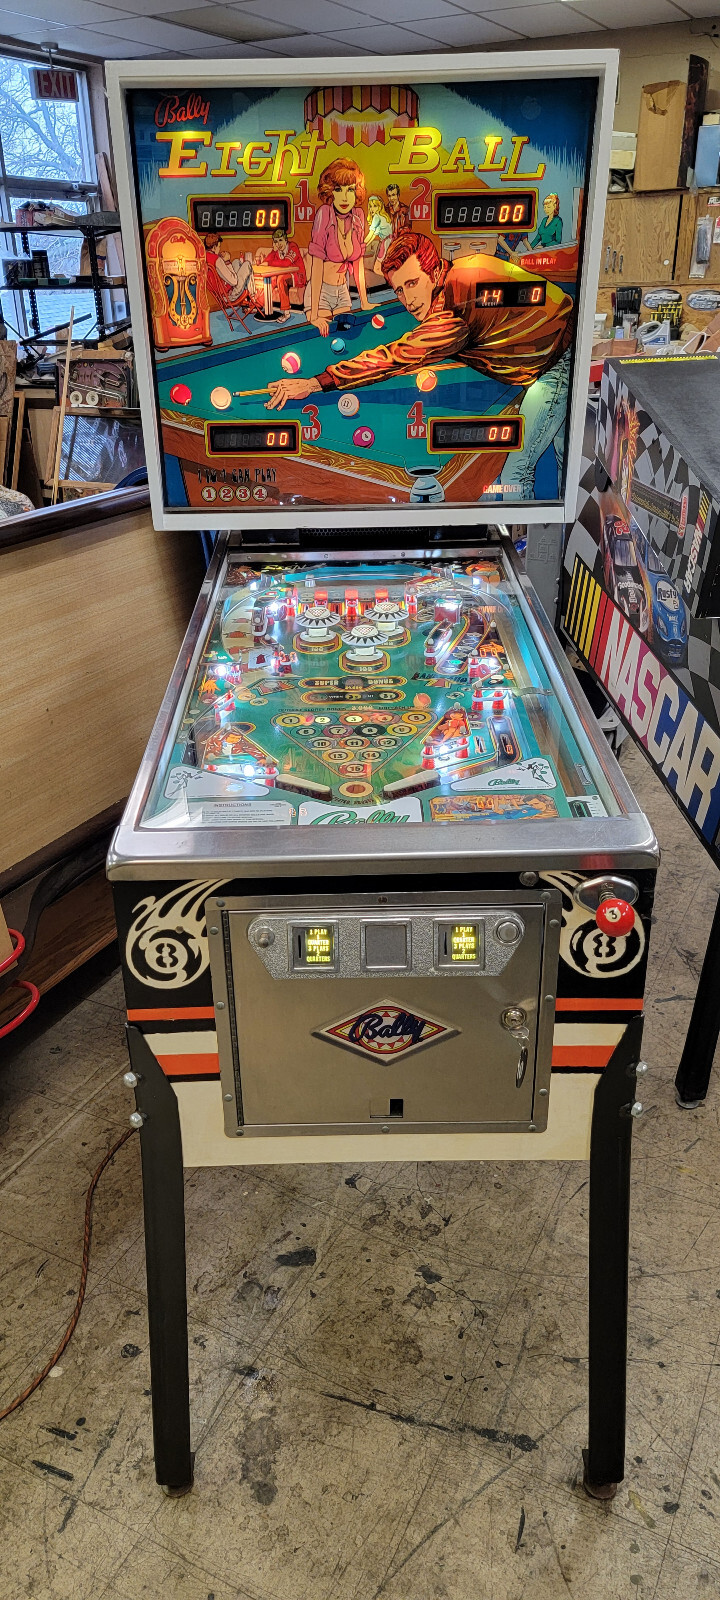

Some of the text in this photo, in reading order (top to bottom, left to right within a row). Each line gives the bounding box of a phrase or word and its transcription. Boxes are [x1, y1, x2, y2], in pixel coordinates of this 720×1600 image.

[40, 71, 73, 98] EXIT
[154, 93, 210, 127] Bally
[388, 127, 546, 181] BALL
[297, 206, 313, 221] UP
[413, 204, 429, 218] UP
[170, 235, 186, 243] Bally
[520, 258, 534, 266] BALL
[543, 257, 557, 265] PLAY
[303, 427, 318, 439] UP
[410, 425, 425, 437] UP
[232, 468, 250, 483] CAN
[255, 468, 277, 482] PLAY
[483, 485, 503, 494] GAME
[658, 588, 677, 601] Rusty
[600, 606, 720, 830] NASCAR
[609, 909, 617, 920] 3
[592, 932, 617, 958] 8
[155, 943, 179, 968] 8
[348, 1013, 426, 1044] Bally
